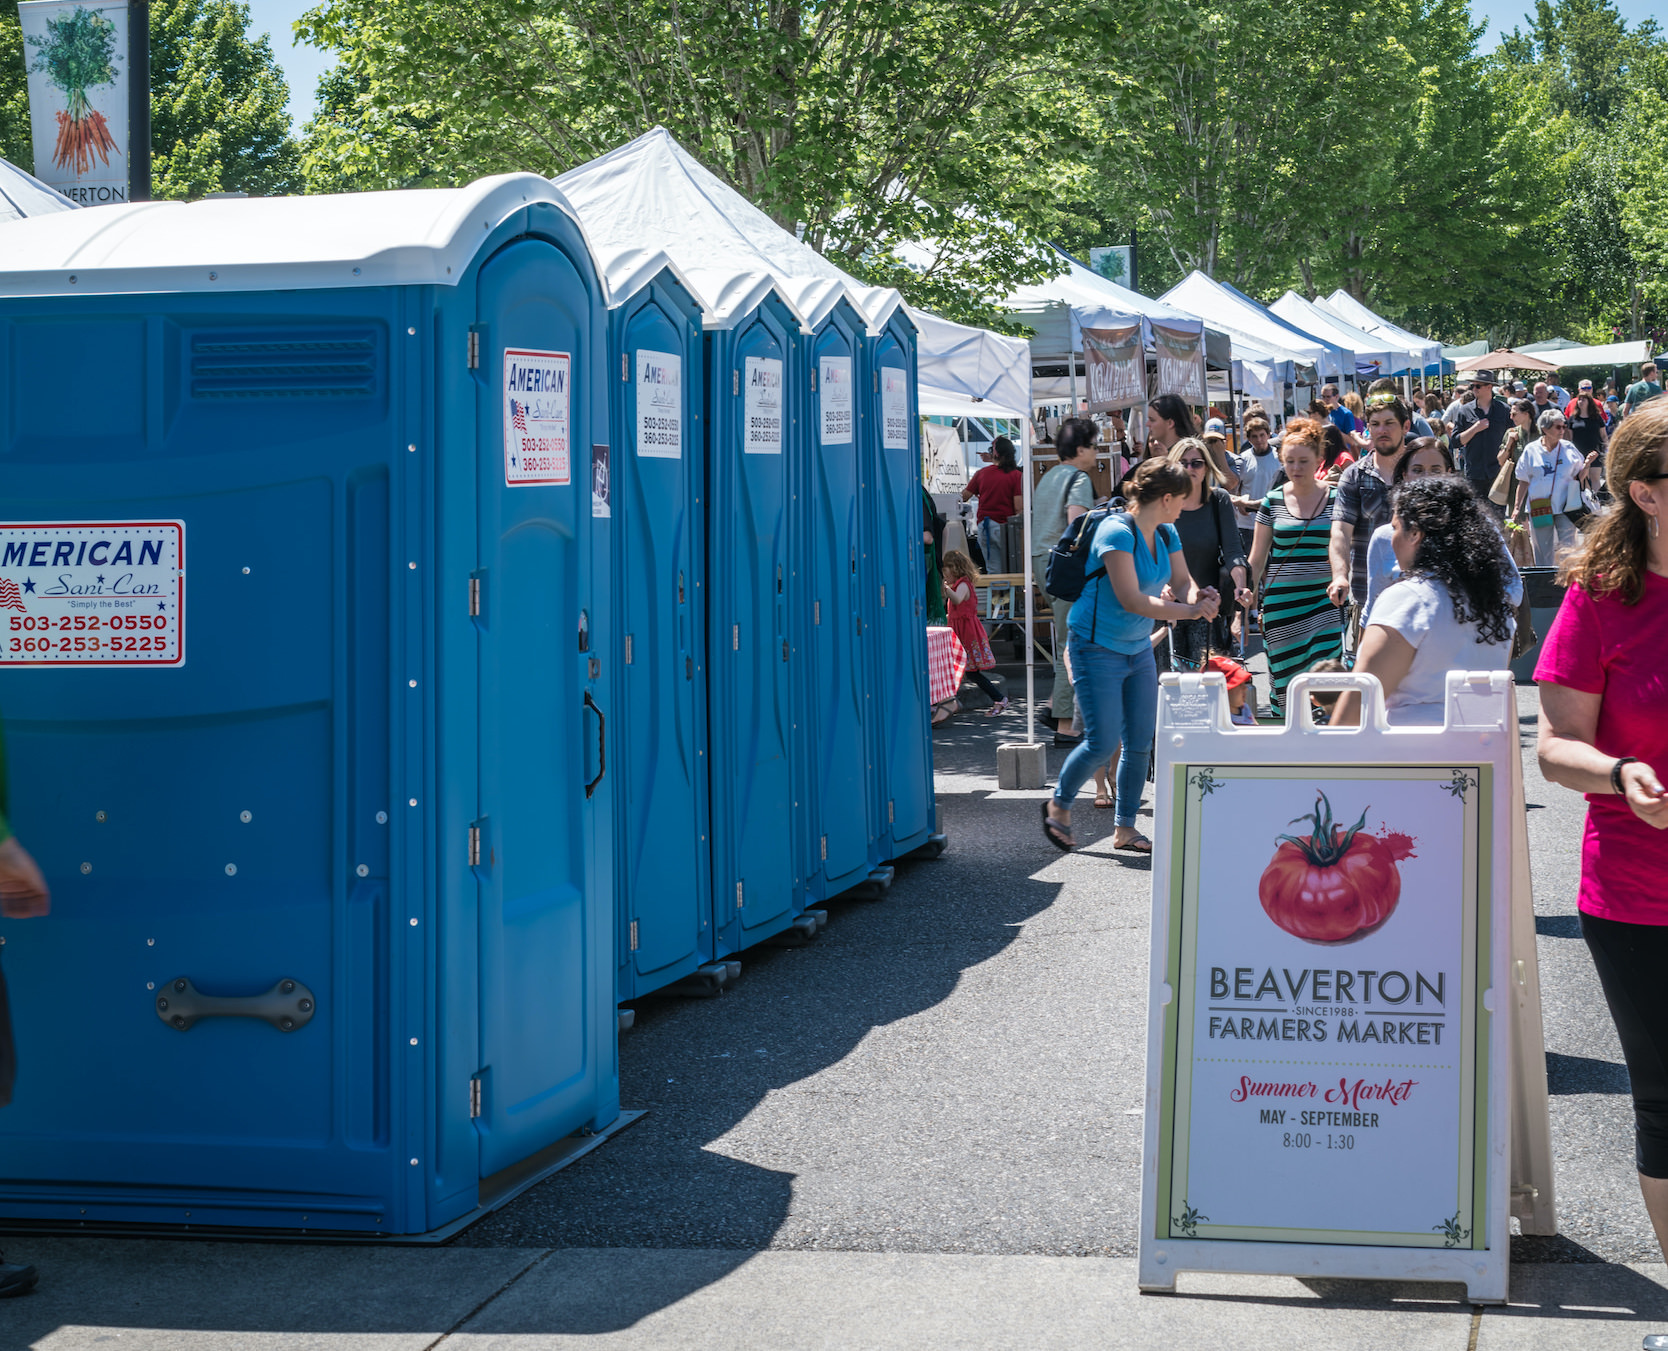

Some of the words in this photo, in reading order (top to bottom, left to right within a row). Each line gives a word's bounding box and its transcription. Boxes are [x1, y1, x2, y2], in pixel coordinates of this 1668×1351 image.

[58, 186, 124, 202] VERTON
[508, 363, 565, 393] AMERICAN
[643, 362, 679, 386] AMER
[751, 368, 780, 388] AMERCAN
[751, 417, 780, 429] 503-252-
[522, 438, 566, 452] 503-252-0550
[750, 431, 780, 442] 360-253-5
[523, 457, 566, 471] 360-253-5225
[44, 573, 160, 595] Sani-Can
[67, 600, 97, 610] "Simply
[99, 600, 112, 608] the
[114, 599, 136, 608] Best"
[9, 615, 167, 631] 503-252-0550
[9, 636, 167, 652] 360-253-5225
[1209, 966, 1446, 1008] BEAVERTON
[1208, 1016, 1328, 1043] FARMERS
[1336, 1019, 1446, 1045] MARKET
[1230, 1075, 1319, 1103] Summer
[1324, 1077, 1420, 1112] Market
[1259, 1109, 1287, 1125] MAY
[1300, 1110, 1379, 1128] SEPTEMBER
[1283, 1132, 1312, 1149] 8:00
[1326, 1134, 1355, 1150] 1:30
